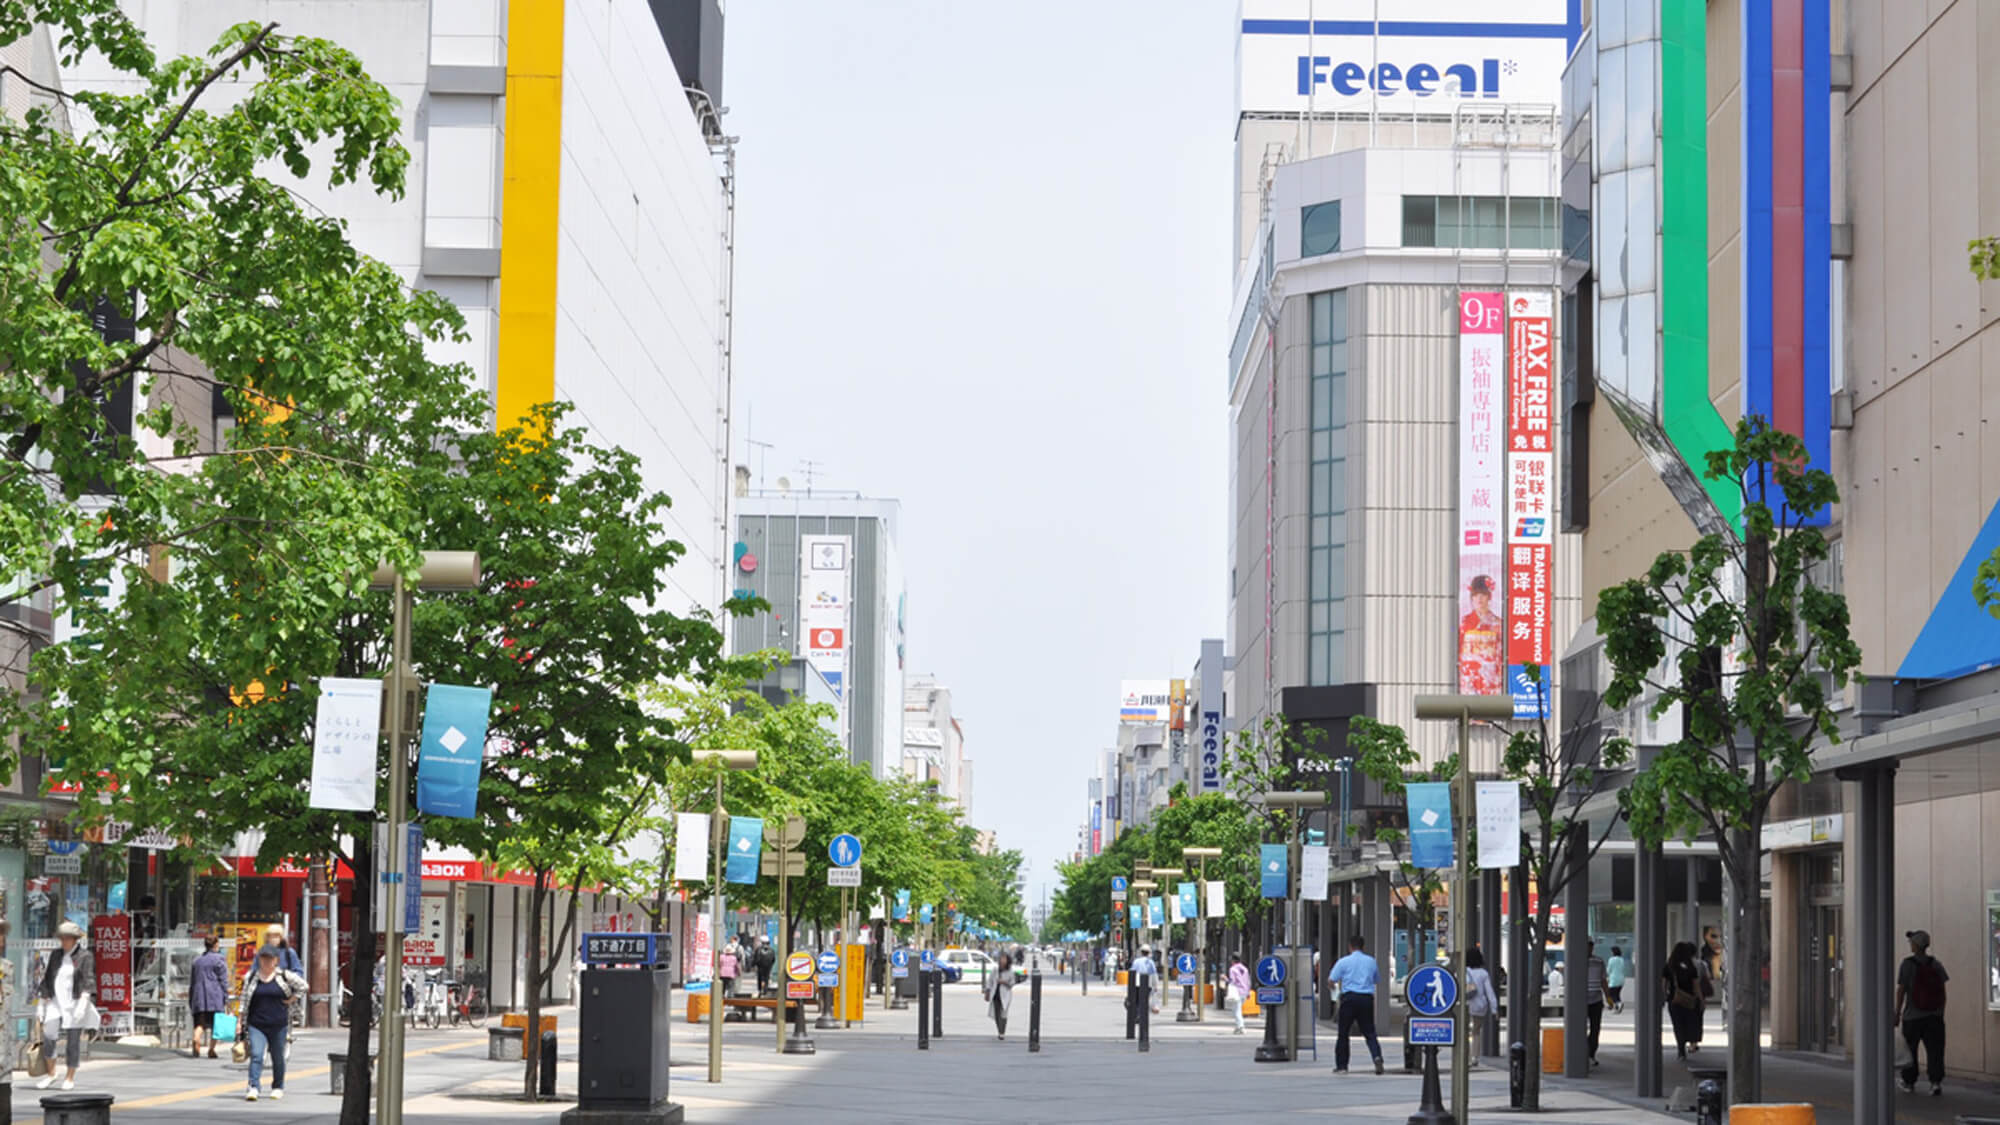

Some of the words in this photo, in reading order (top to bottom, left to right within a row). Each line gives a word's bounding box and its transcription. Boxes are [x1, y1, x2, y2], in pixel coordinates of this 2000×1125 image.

[1297, 55, 1500, 98] Feeeal
[1463, 297, 1500, 328] 9F
[1528, 320, 1547, 370] TAX
[1528, 376, 1547, 430] FREE
[1515, 460, 1527, 513] 可以使用
[1528, 460, 1545, 513] 银联卡
[1513, 547, 1531, 640] 翻译服务
[1534, 547, 1546, 627] TRANSLATION
[1534, 629, 1543, 662] SERVICE
[1203, 711, 1220, 788] Feeeal
[96, 940, 128, 953] FREE
